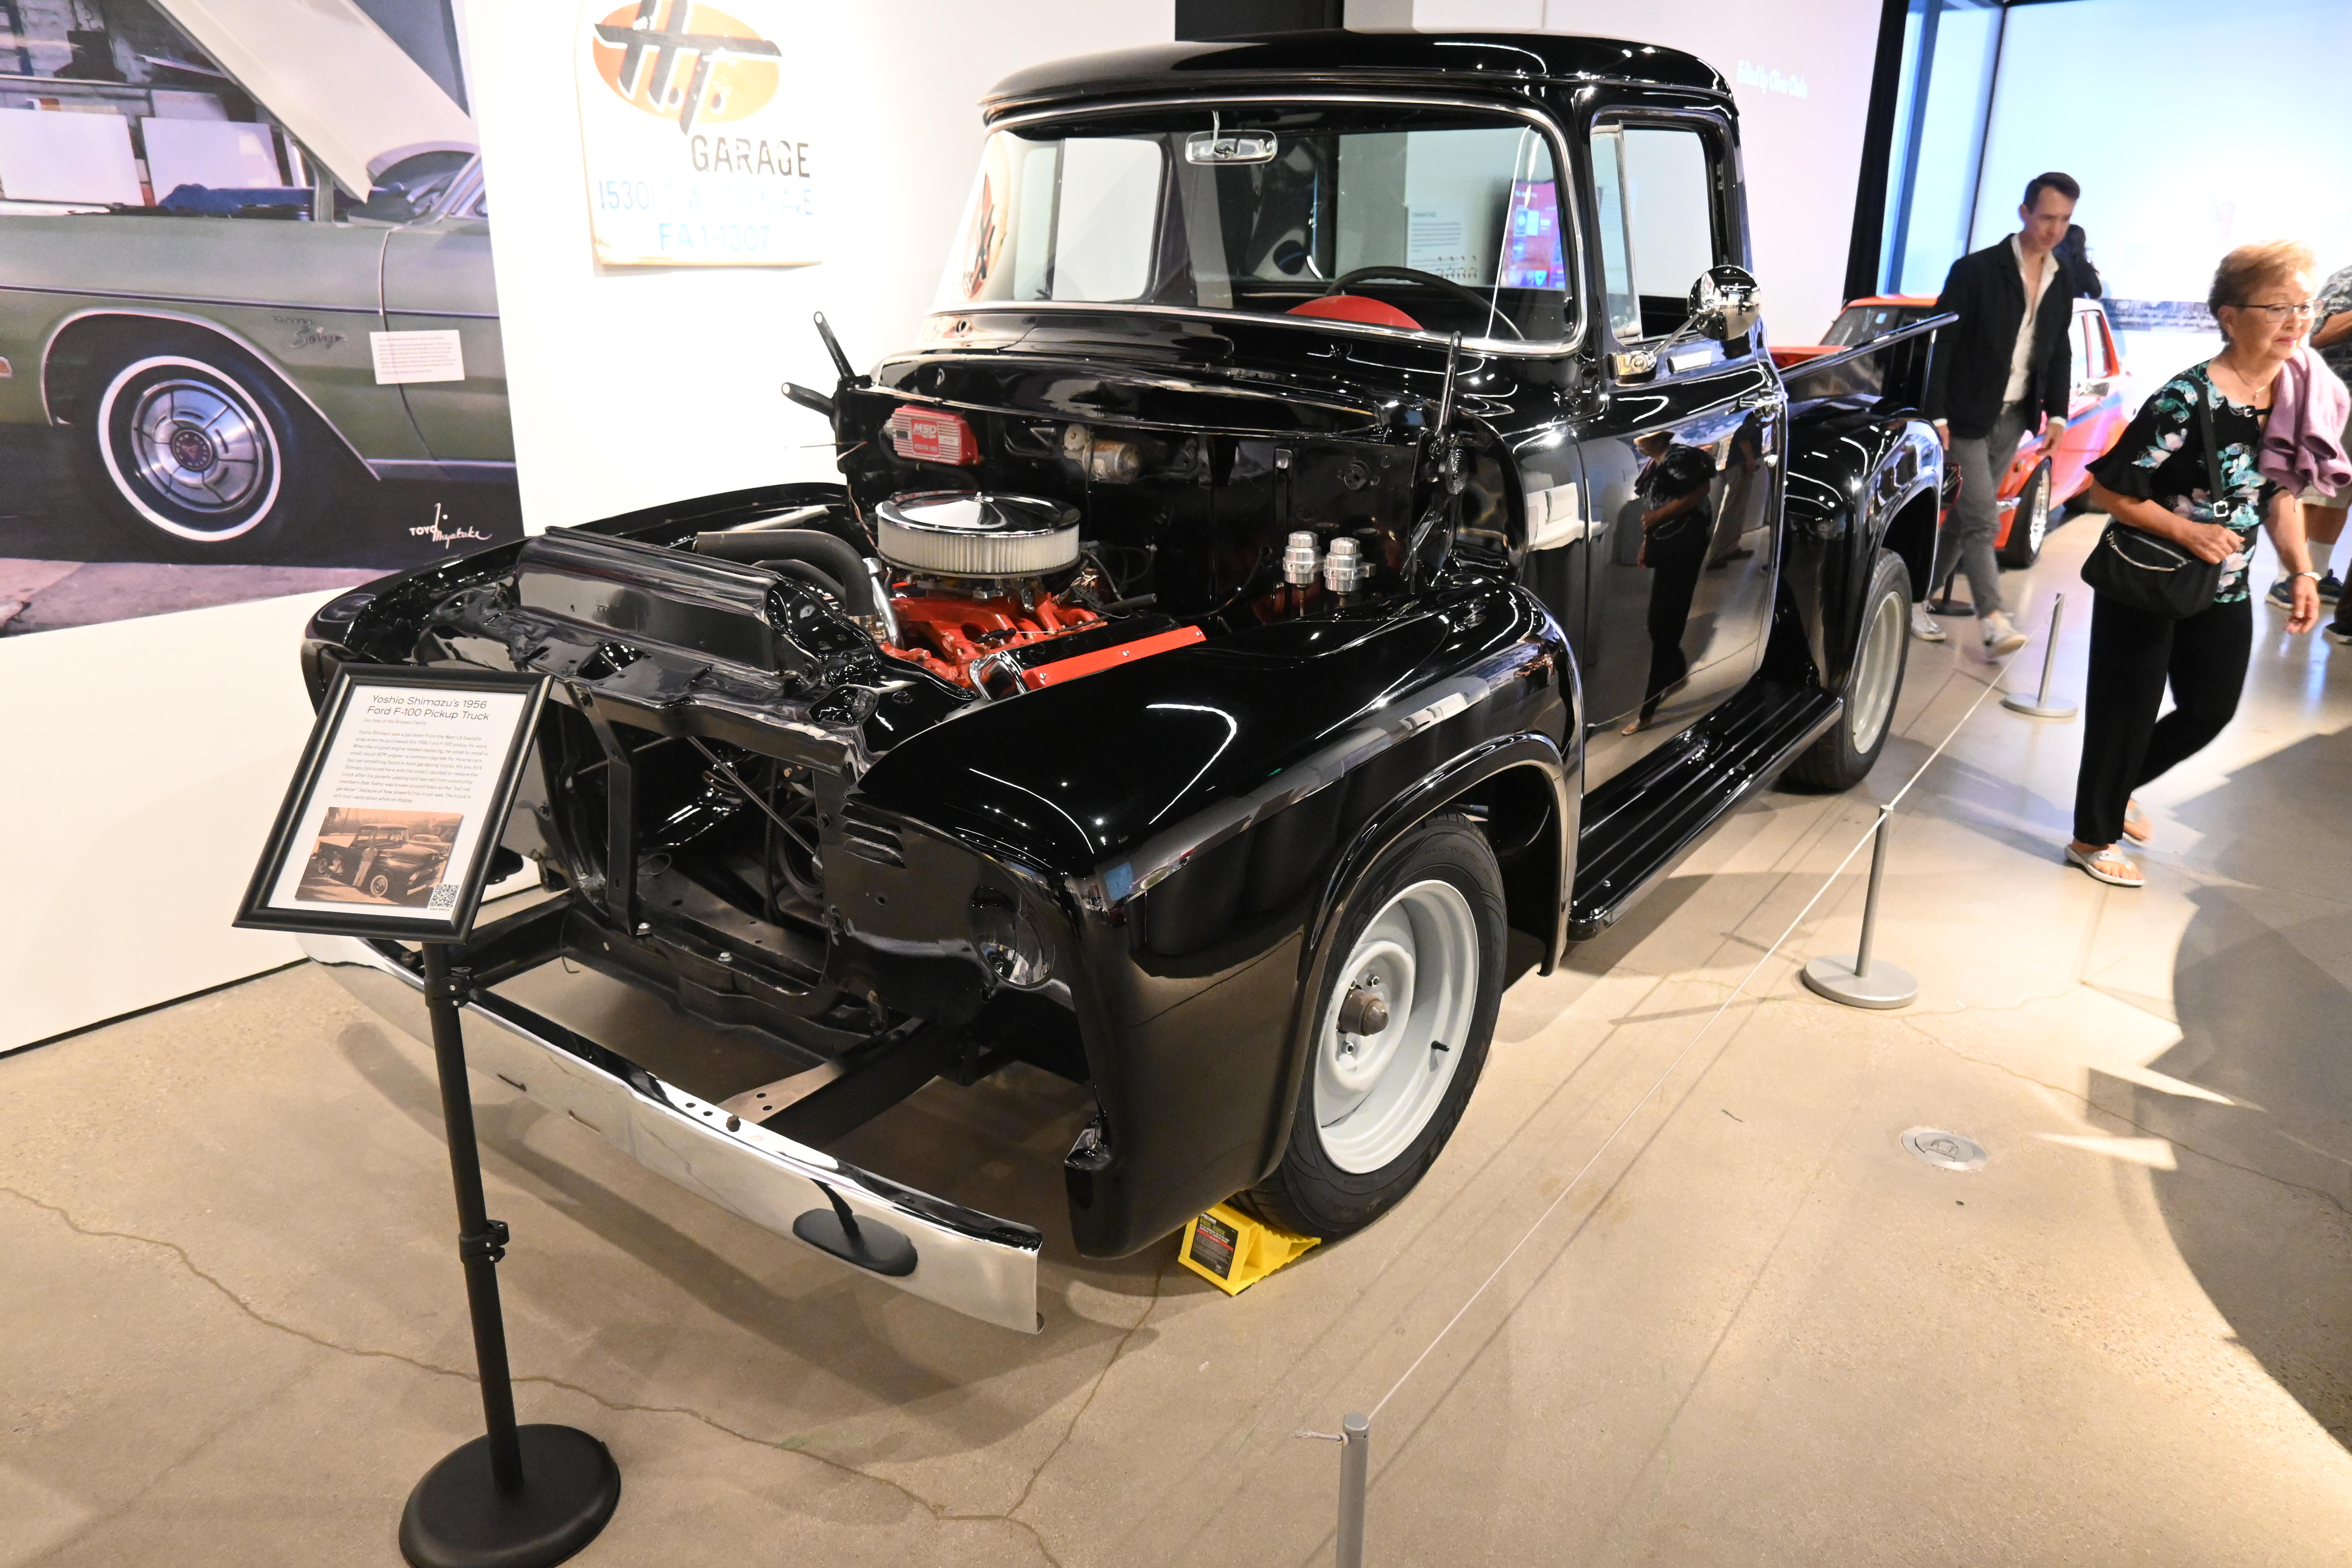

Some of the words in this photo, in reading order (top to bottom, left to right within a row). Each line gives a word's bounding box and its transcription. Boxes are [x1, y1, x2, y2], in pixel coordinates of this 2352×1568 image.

[691, 134, 811, 178] GARAGE
[912, 422, 937, 435] MSD
[409, 525, 438, 536] TOYO
[373, 695, 404, 704] Yoshio
[463, 700, 487, 708] 1956
[367, 706, 392, 715] Ford
[393, 708, 422, 716] F-100
[424, 709, 458, 720] Pickup
[463, 711, 489, 720] Truck
